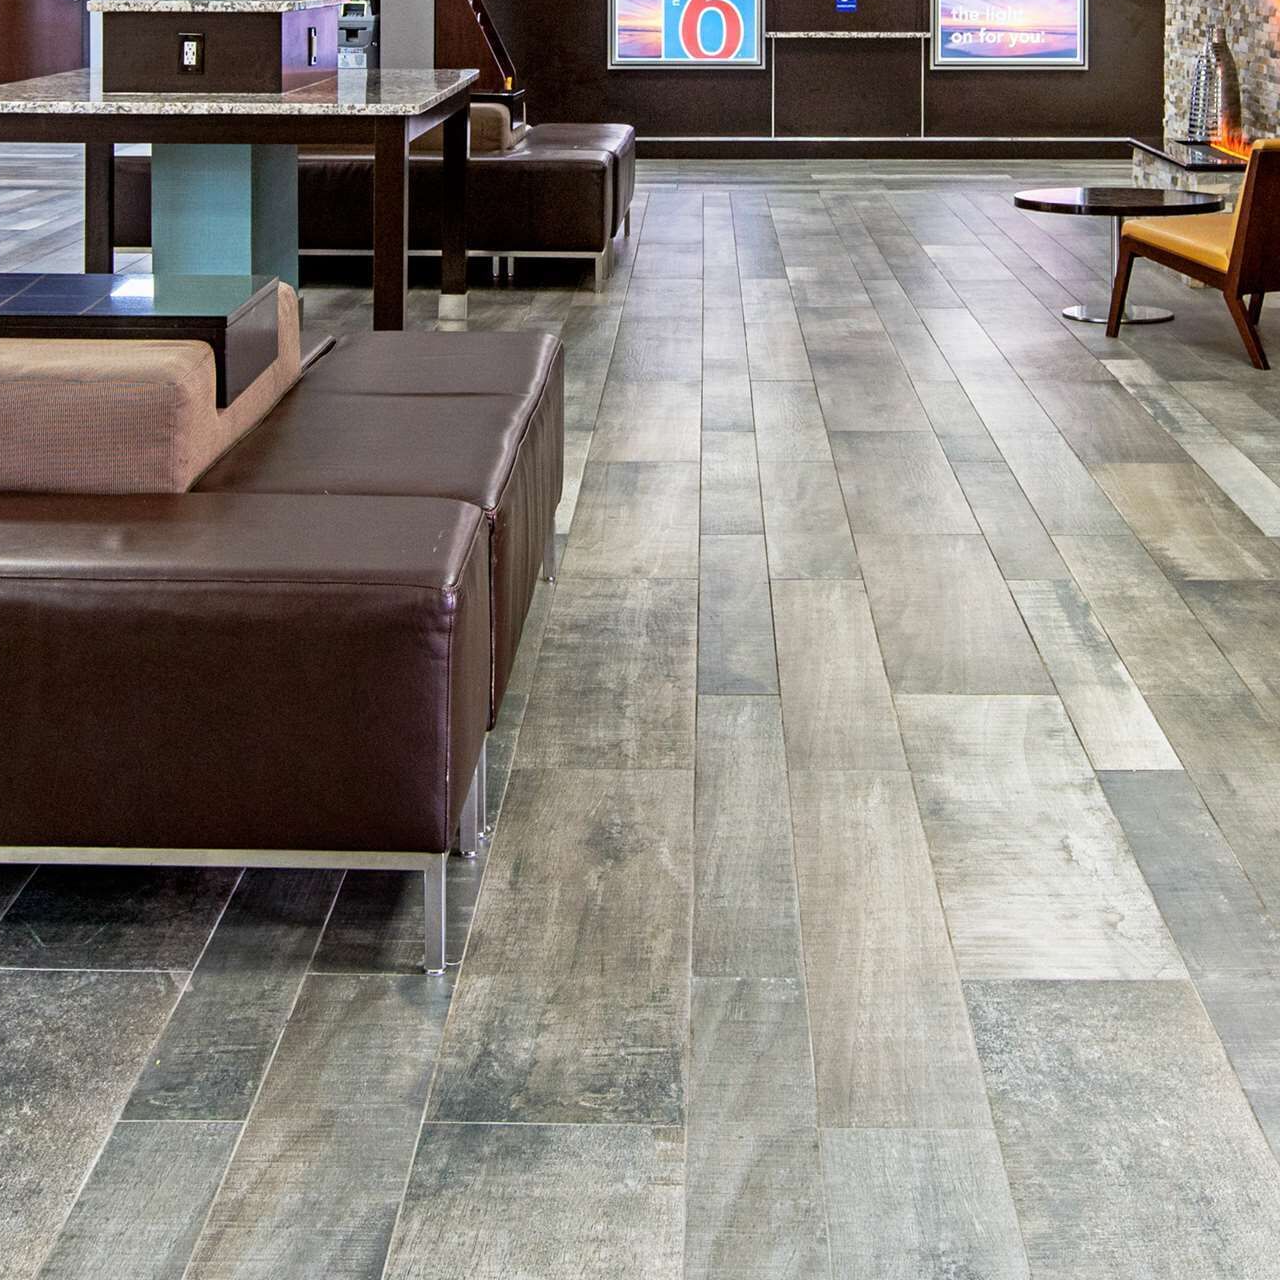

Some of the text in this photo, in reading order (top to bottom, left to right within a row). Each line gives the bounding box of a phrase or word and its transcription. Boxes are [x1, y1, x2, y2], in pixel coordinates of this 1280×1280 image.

[951, 6, 980, 21] the
[951, 32, 973, 44] on
[979, 28, 1005, 44] for
